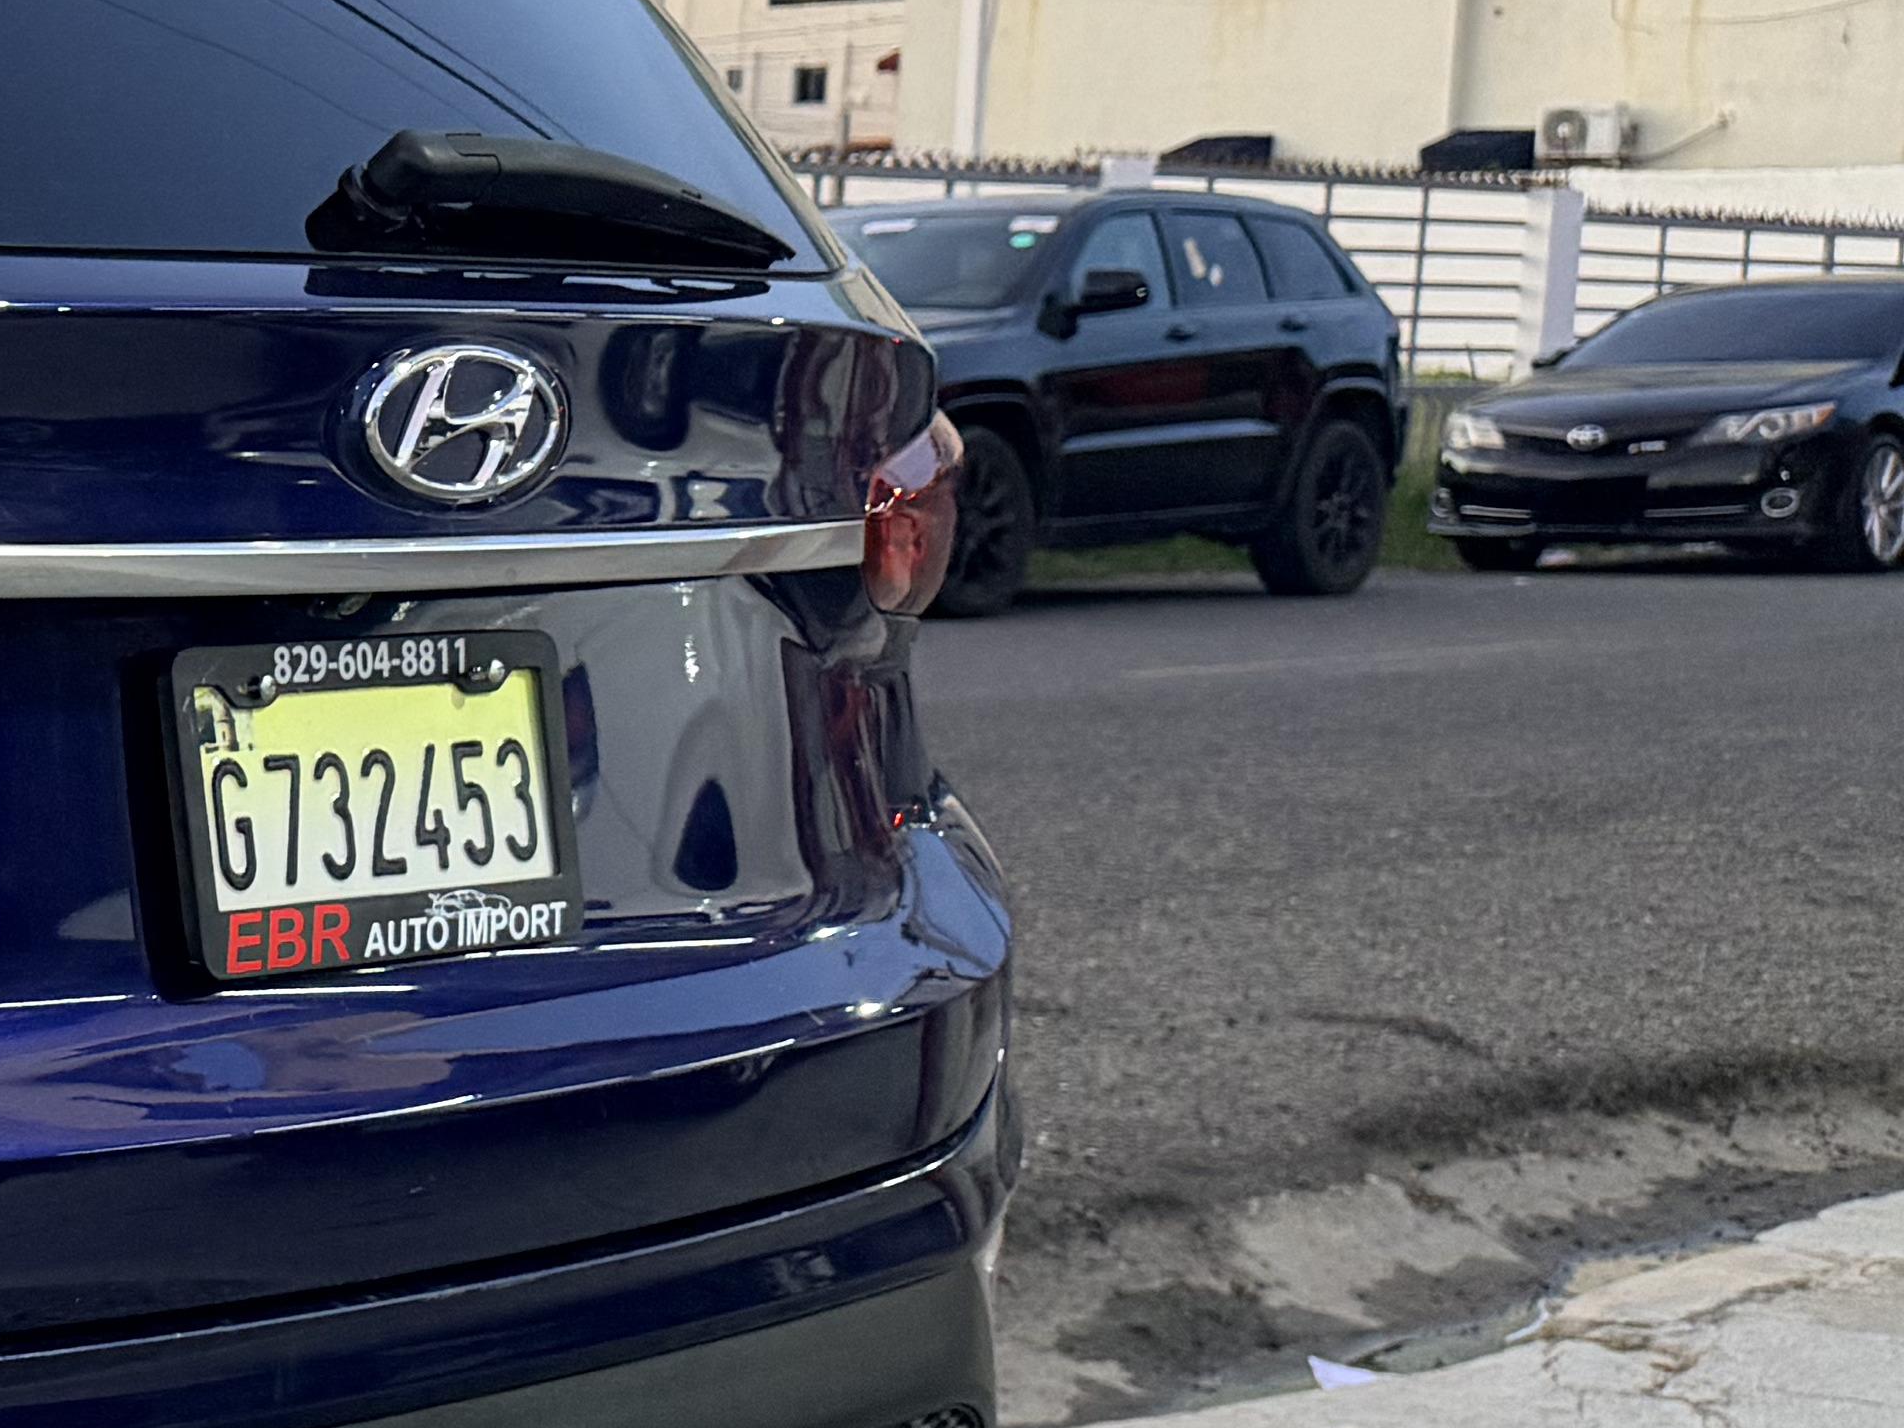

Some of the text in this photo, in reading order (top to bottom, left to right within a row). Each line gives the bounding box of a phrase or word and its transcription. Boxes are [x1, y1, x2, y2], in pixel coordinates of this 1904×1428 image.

[273, 637, 468, 684] 829-604-8811
[211, 738, 538, 891] G732453
[226, 902, 567, 974] EBR AUTO IMPORT
